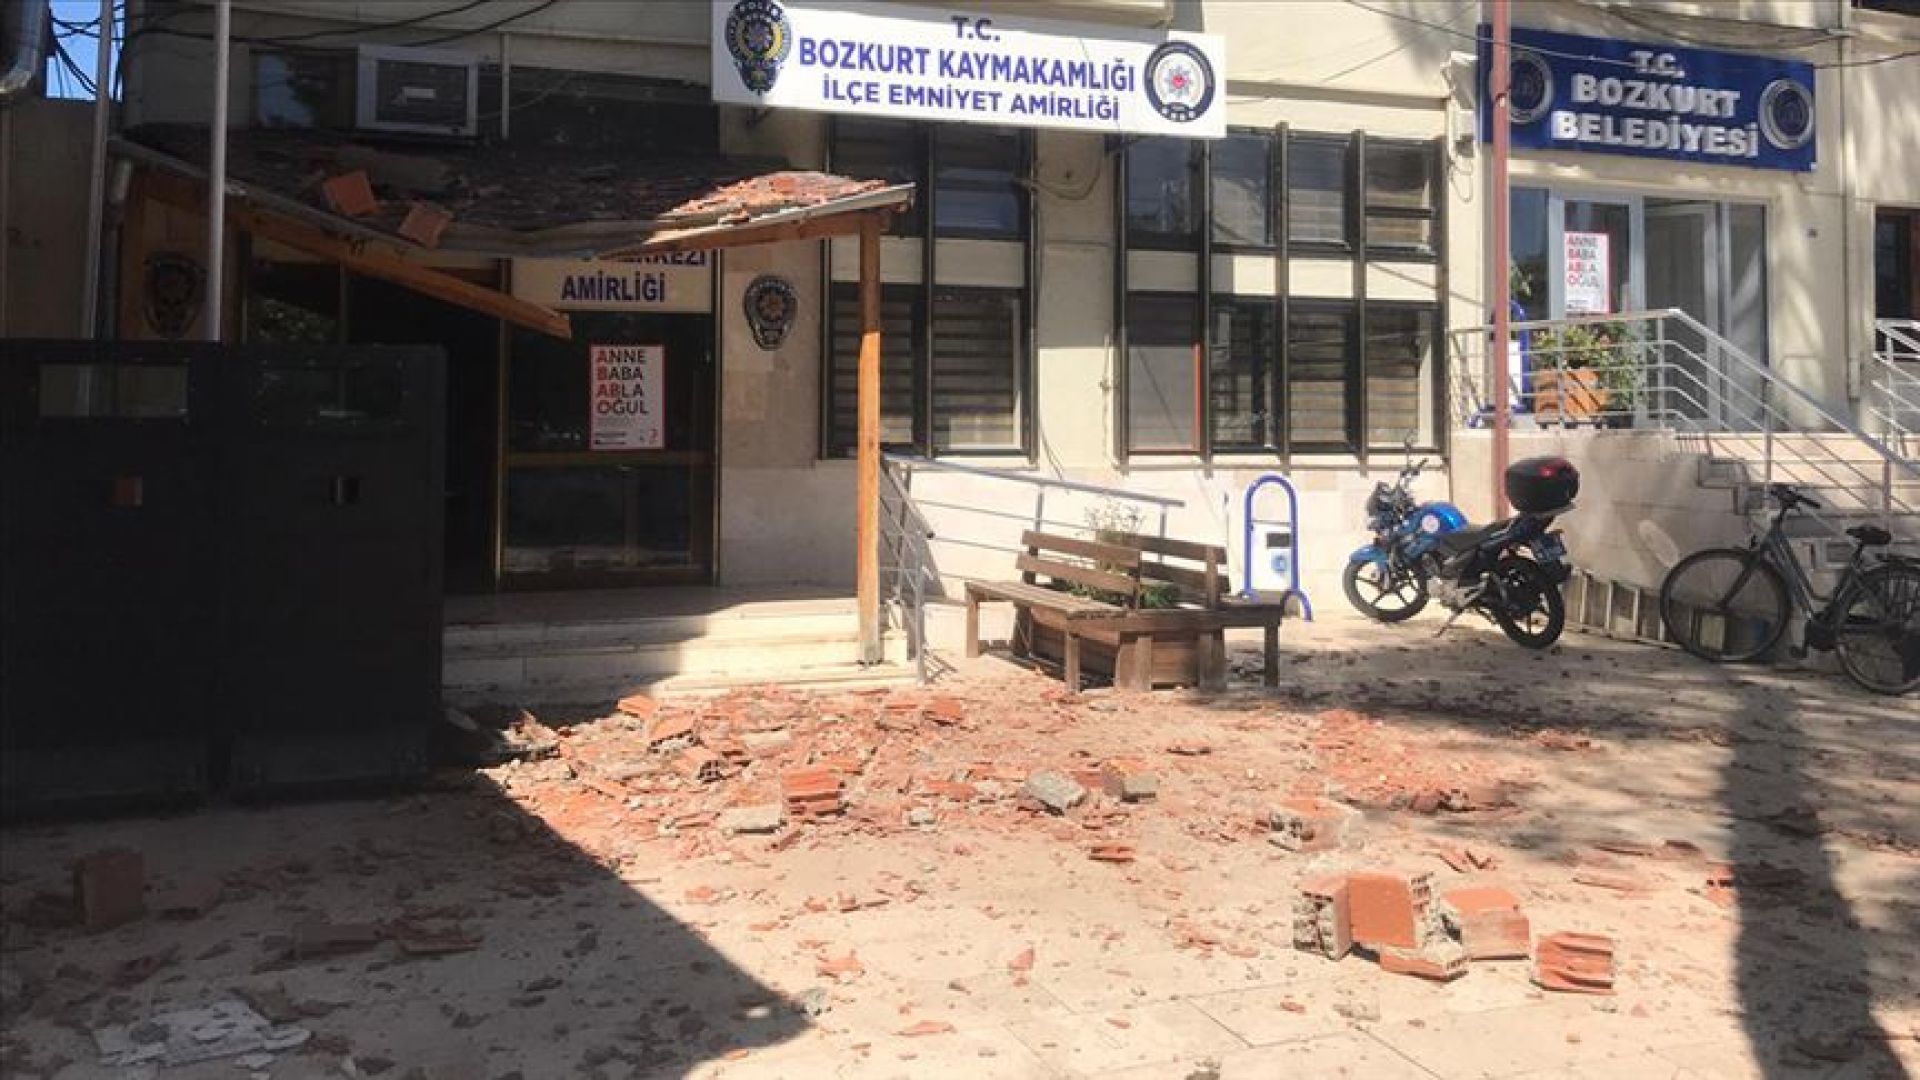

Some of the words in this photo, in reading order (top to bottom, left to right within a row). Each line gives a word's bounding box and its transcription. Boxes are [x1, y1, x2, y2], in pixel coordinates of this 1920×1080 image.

[952, 16, 1001, 42] T.C.
[799, 37, 931, 75] BOZKURT
[938, 47, 1135, 93] KAYMAKAMLIĞI
[1631, 50, 1686, 79] T.C.
[822, 73, 880, 104] İLÇE
[888, 79, 1001, 114] EMNİYET
[1010, 90, 1120, 122] AMİRLİĞİ
[1571, 72, 1740, 118] BOZKURT
[1552, 110, 1759, 158] BELEDİYESİ
[561, 270, 665, 302] AMİRLİĞİ
[597, 349, 647, 363] ANNE
[597, 366, 643, 381] BABA
[597, 383, 644, 399] ABLA
[598, 398, 649, 415] OĞUL
